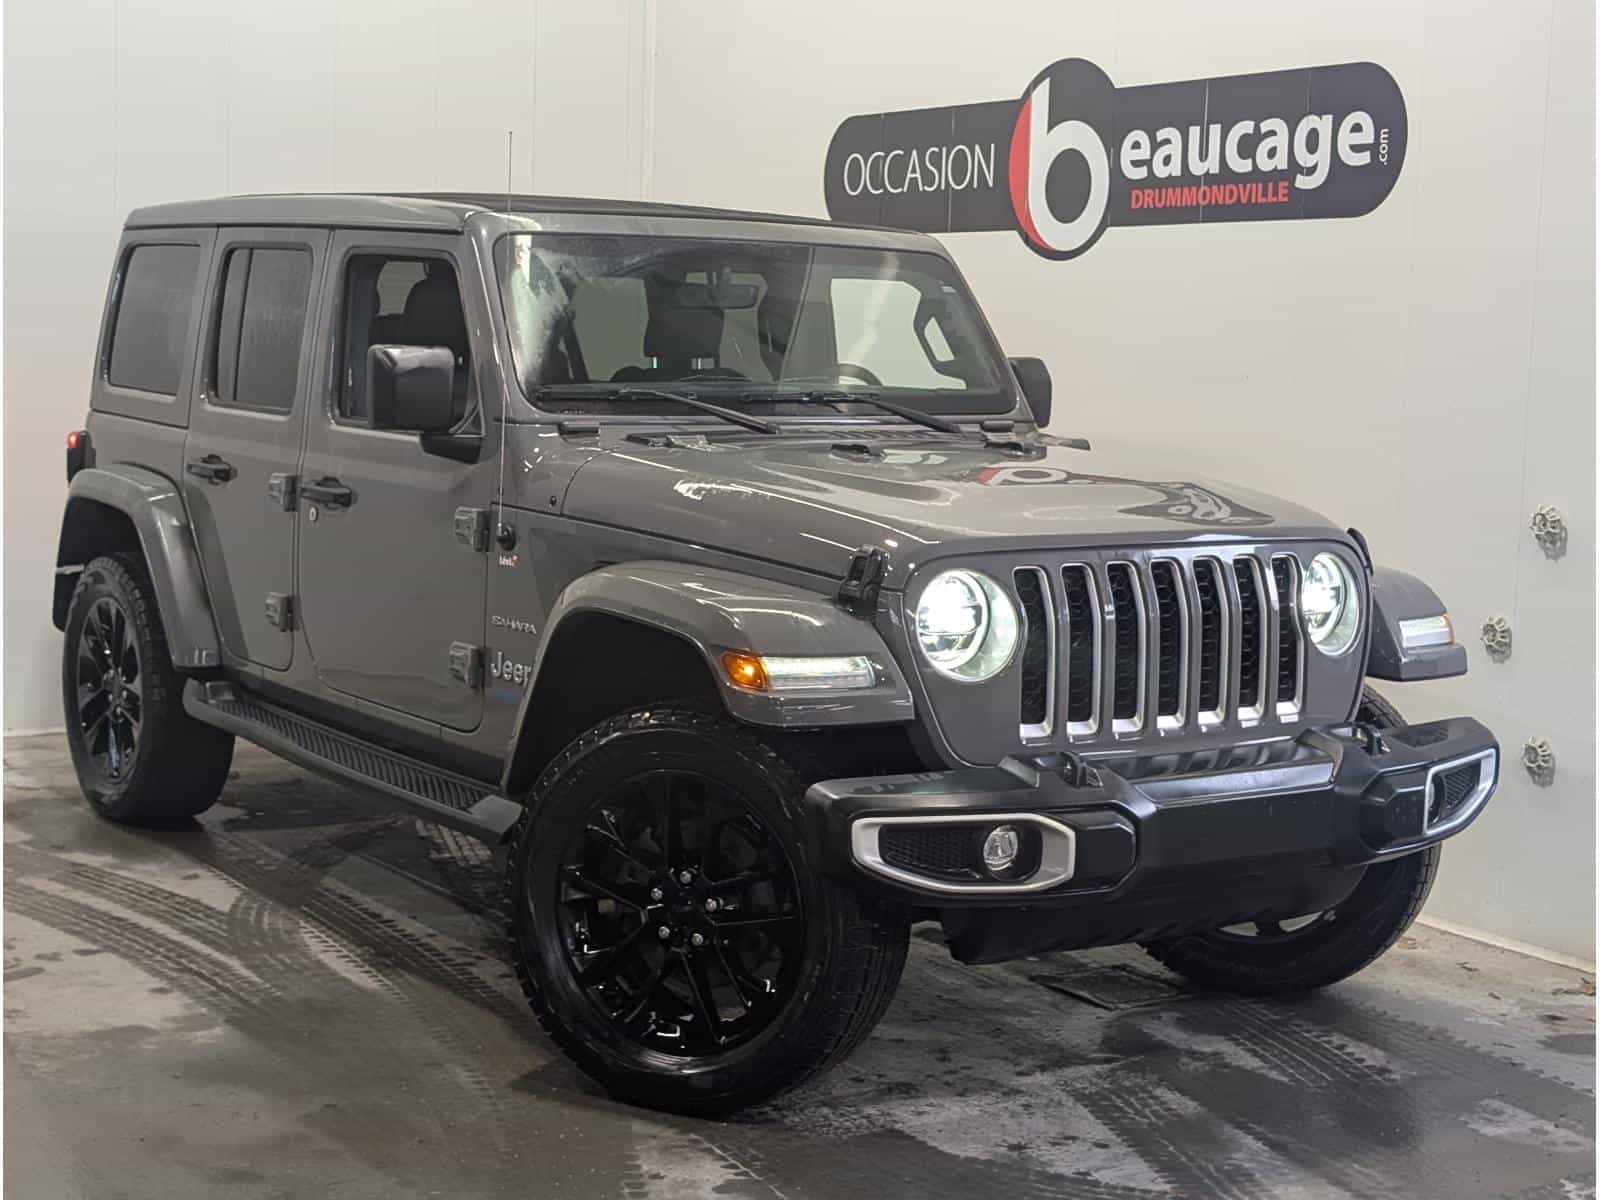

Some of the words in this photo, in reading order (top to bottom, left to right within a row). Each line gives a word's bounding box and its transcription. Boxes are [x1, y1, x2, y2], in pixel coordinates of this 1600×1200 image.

[843, 142, 996, 197] OCCASION
[1130, 180, 1290, 210] DRUMMONDVILLE
[490, 615, 537, 634] SAHARA
